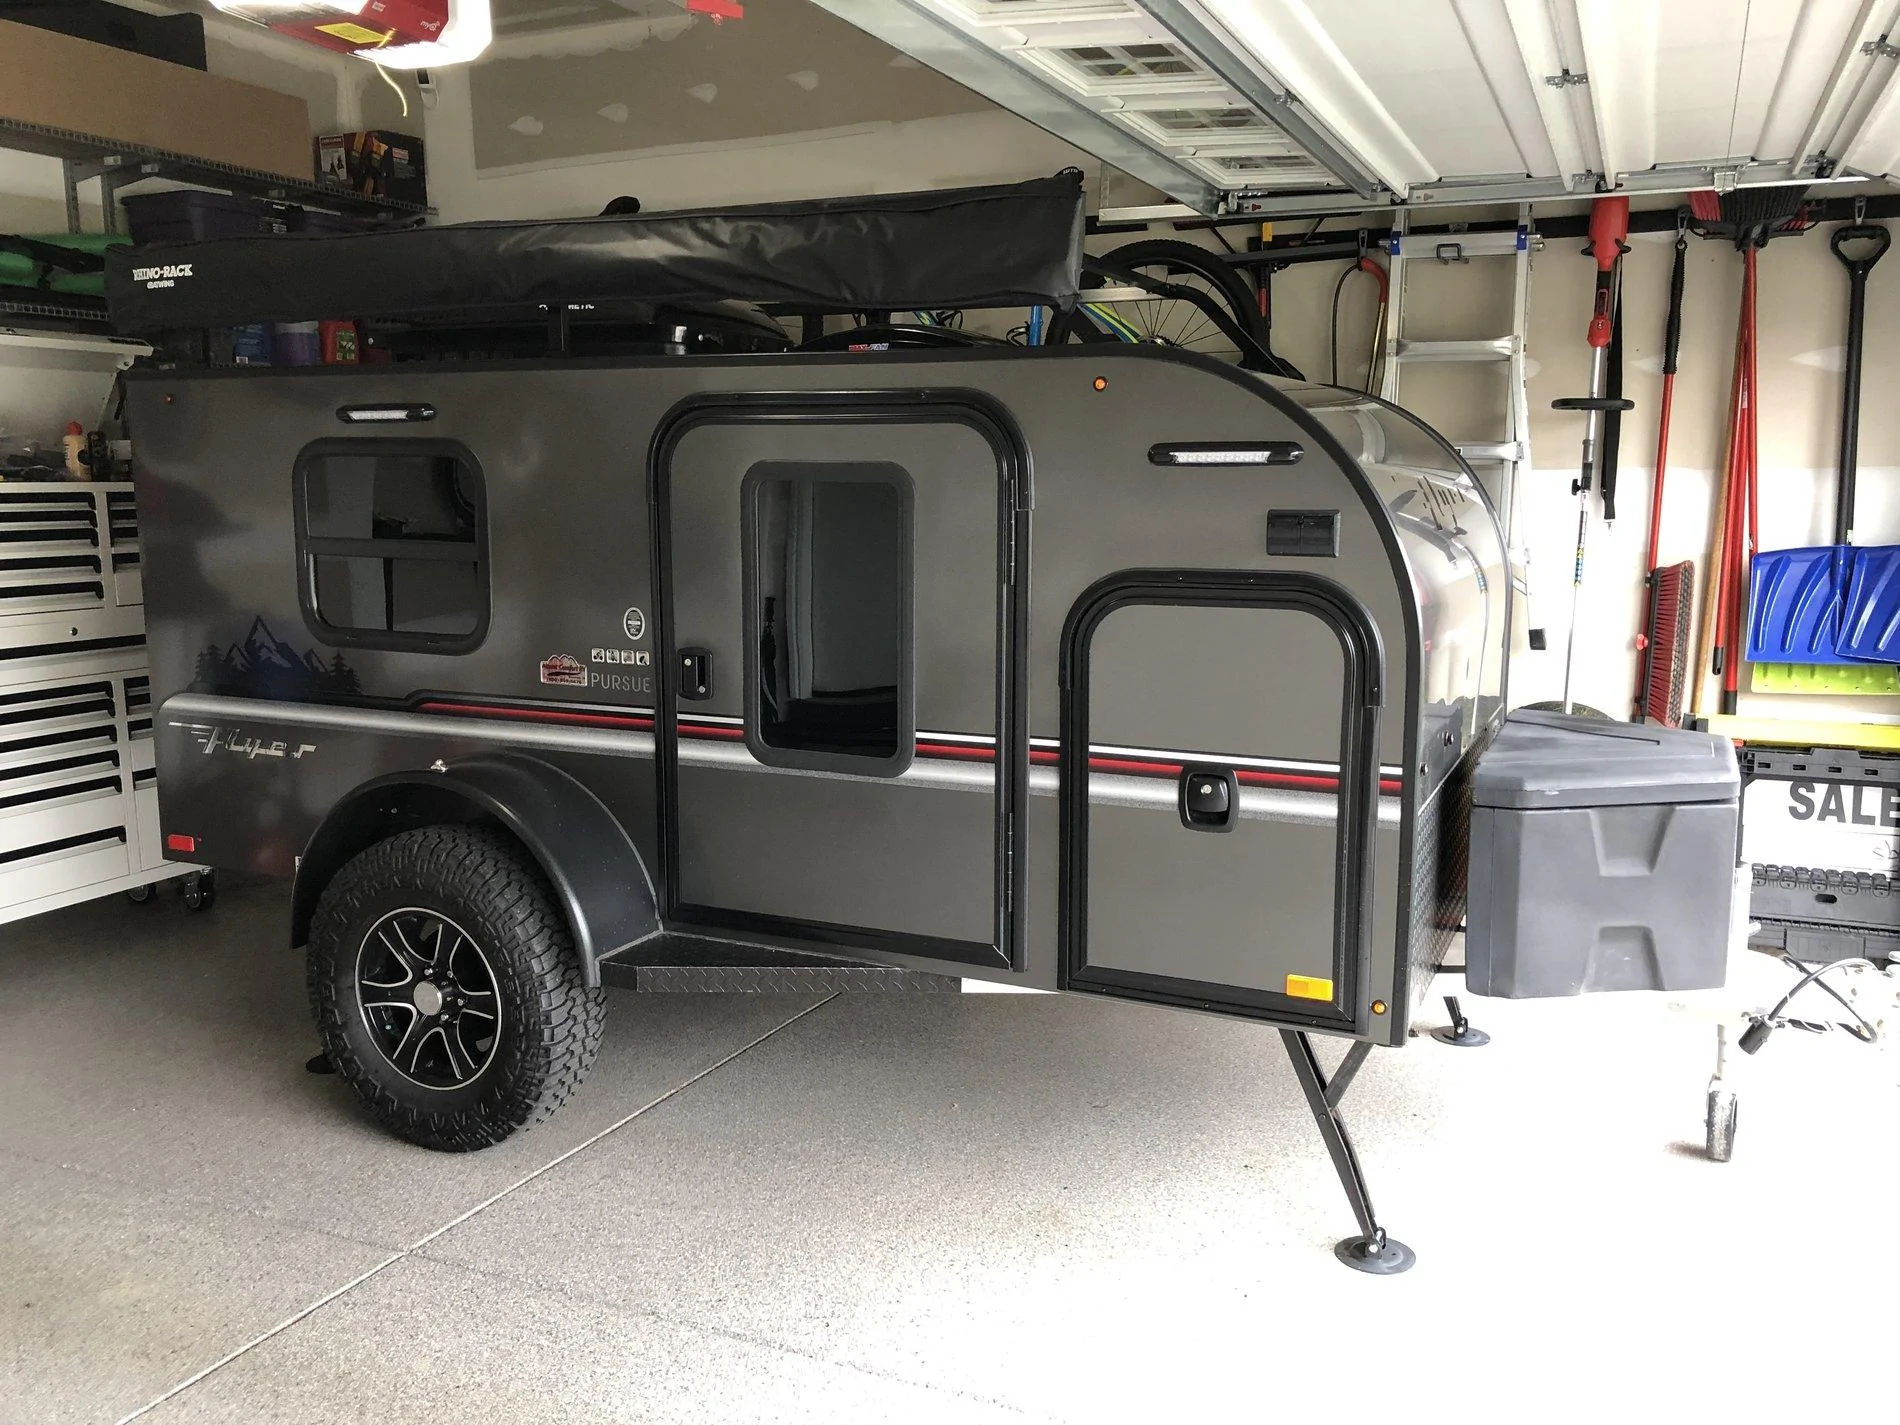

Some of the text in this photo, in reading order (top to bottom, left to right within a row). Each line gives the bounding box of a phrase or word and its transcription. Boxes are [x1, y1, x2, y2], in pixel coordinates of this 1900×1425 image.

[132, 264, 193, 281] RHINO-RACK
[591, 672, 652, 693] PURSUE
[1788, 781, 1900, 828] SALE
